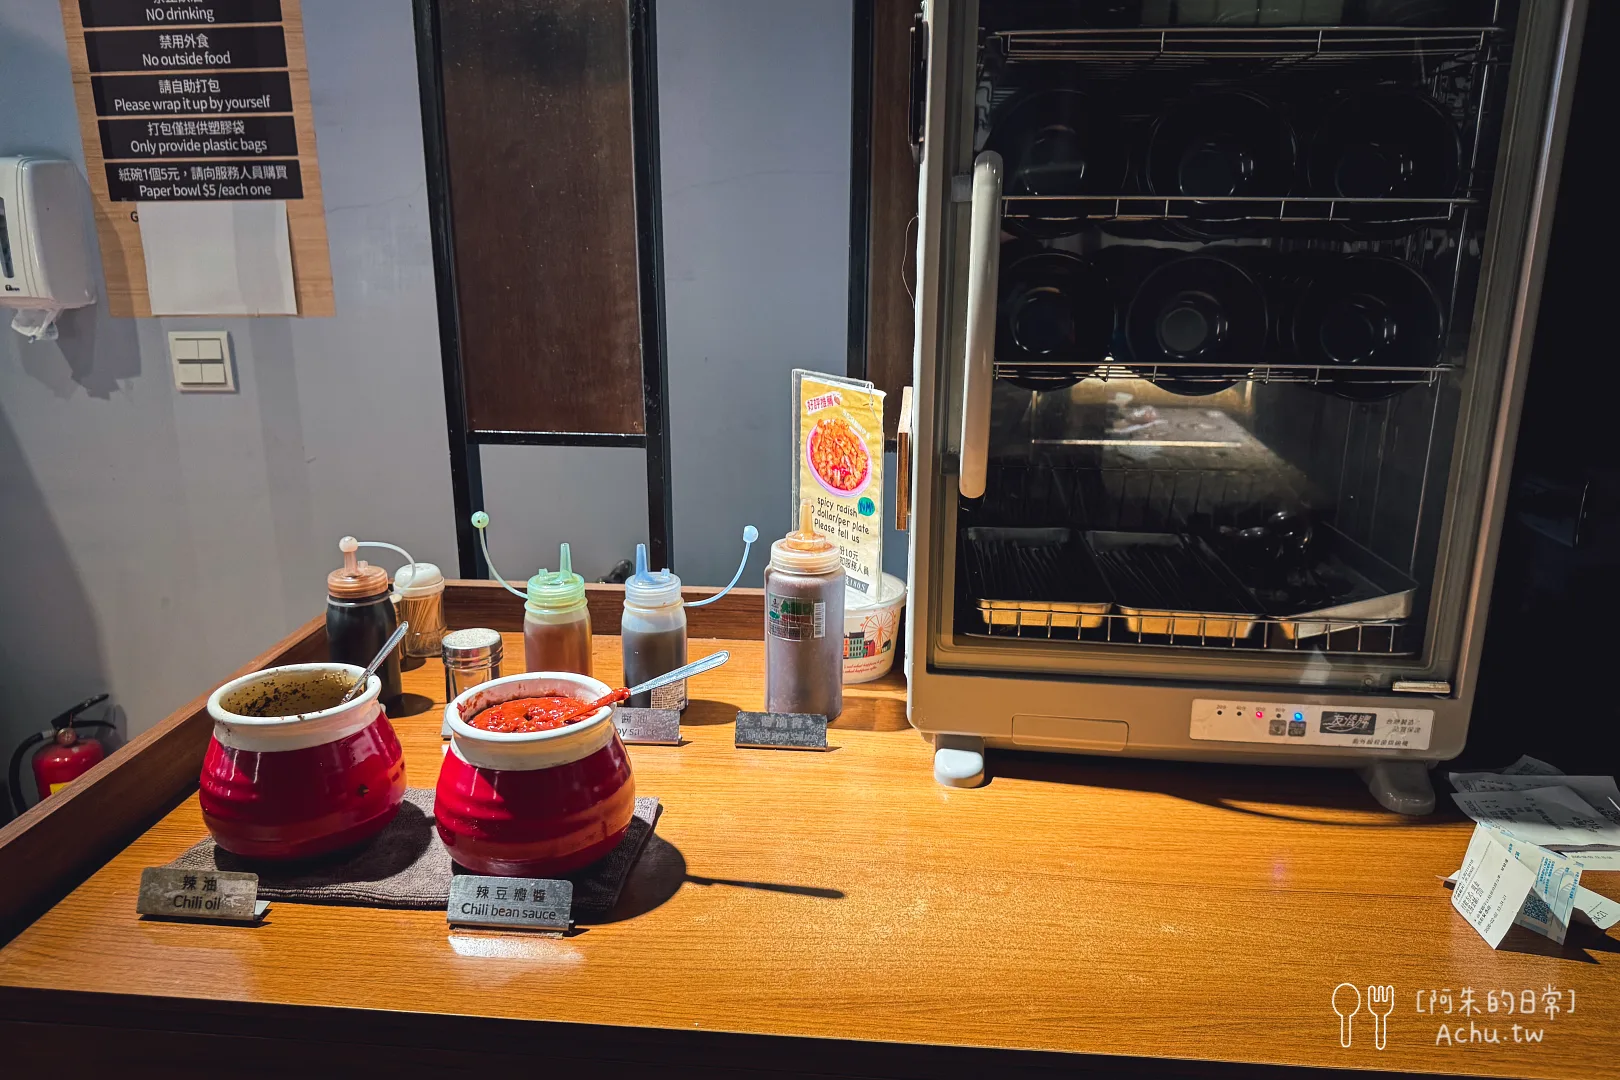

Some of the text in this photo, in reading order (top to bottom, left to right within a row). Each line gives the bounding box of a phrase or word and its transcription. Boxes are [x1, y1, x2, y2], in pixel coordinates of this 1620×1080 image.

[146, 6, 215, 22] NO drinking
[159, 33, 209, 49] 禁用外食
[142, 51, 231, 66] No outside food
[158, 78, 220, 93] 請自助打包
[114, 95, 271, 113] Please wrap it up by yourself
[147, 120, 245, 136] 打包僅提供塑膠袋
[130, 138, 268, 155] Only provide plastic bags
[139, 183, 272, 199] Paper bowl $5 /each one
[838, 527, 849, 540] tell
[851, 534, 860, 544] us
[852, 521, 870, 535] plate
[182, 875, 218, 892] 辣油
[173, 895, 220, 910] Chili oil
[461, 902, 556, 920] Chili bean sauce
